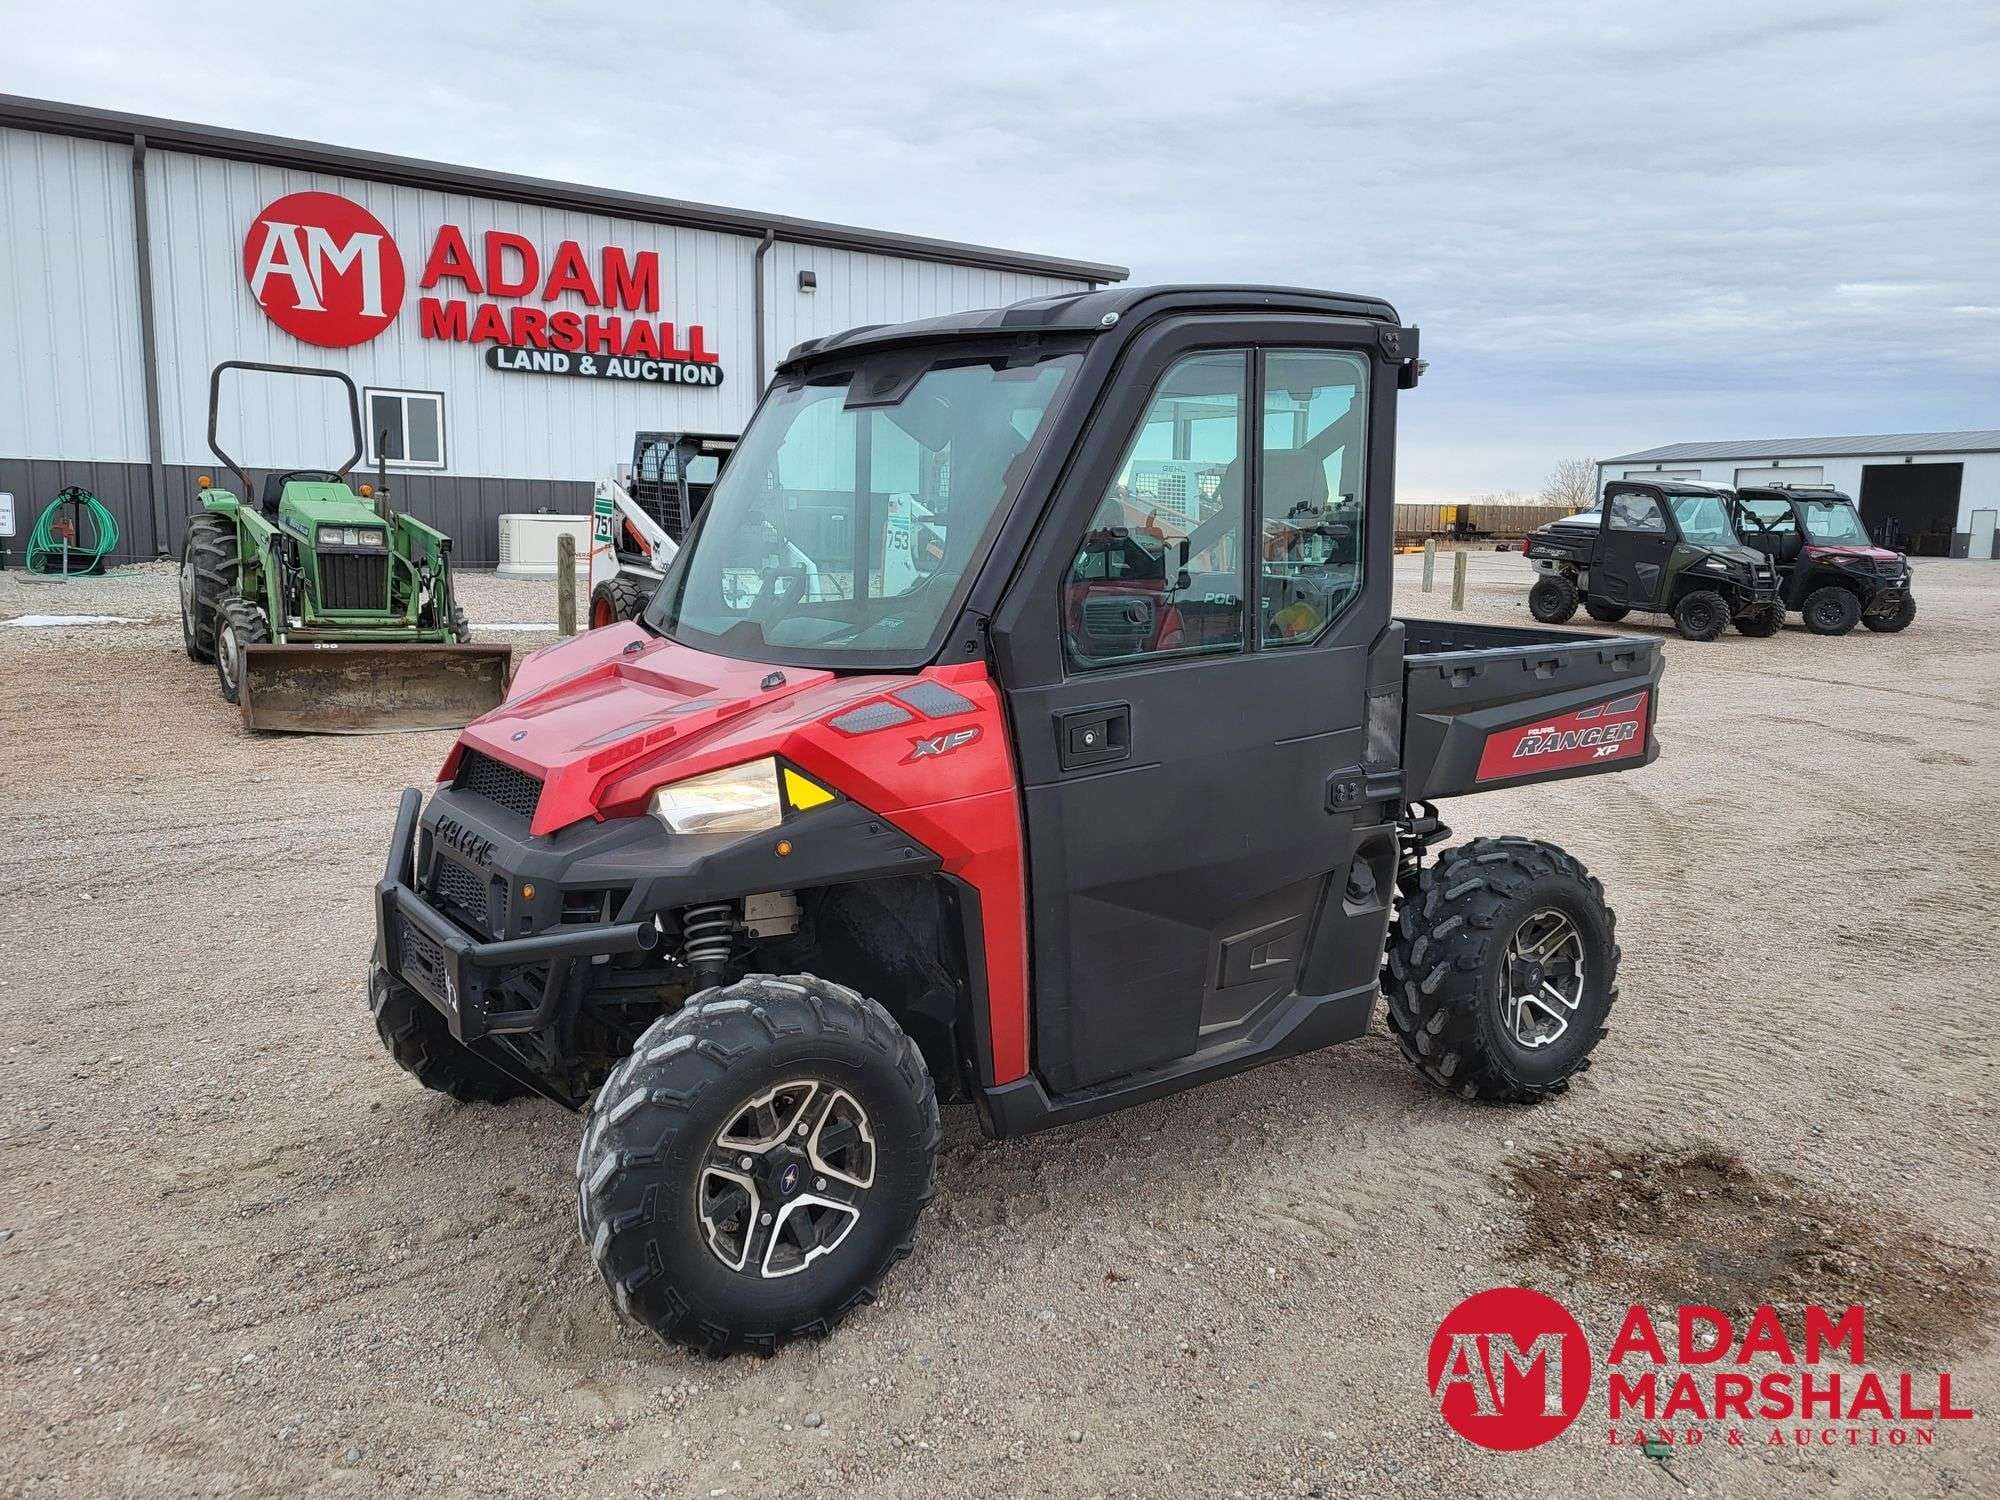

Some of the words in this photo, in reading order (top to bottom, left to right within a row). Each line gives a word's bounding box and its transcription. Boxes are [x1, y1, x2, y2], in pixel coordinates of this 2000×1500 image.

[251, 220, 388, 318] AM
[420, 224, 661, 313] ADAM
[420, 297, 720, 364] MARSHALL
[497, 348, 571, 375] LAND
[579, 354, 599, 376] &
[605, 356, 717, 386] AUCTION
[595, 514, 613, 537] 751
[887, 529, 909, 551] 753
[911, 729, 980, 760] XP
[1512, 720, 1638, 758] RANGER
[1527, 727, 1555, 736] POLARIS
[1593, 745, 1620, 758] XP
[434, 814, 501, 868] POLARIS
